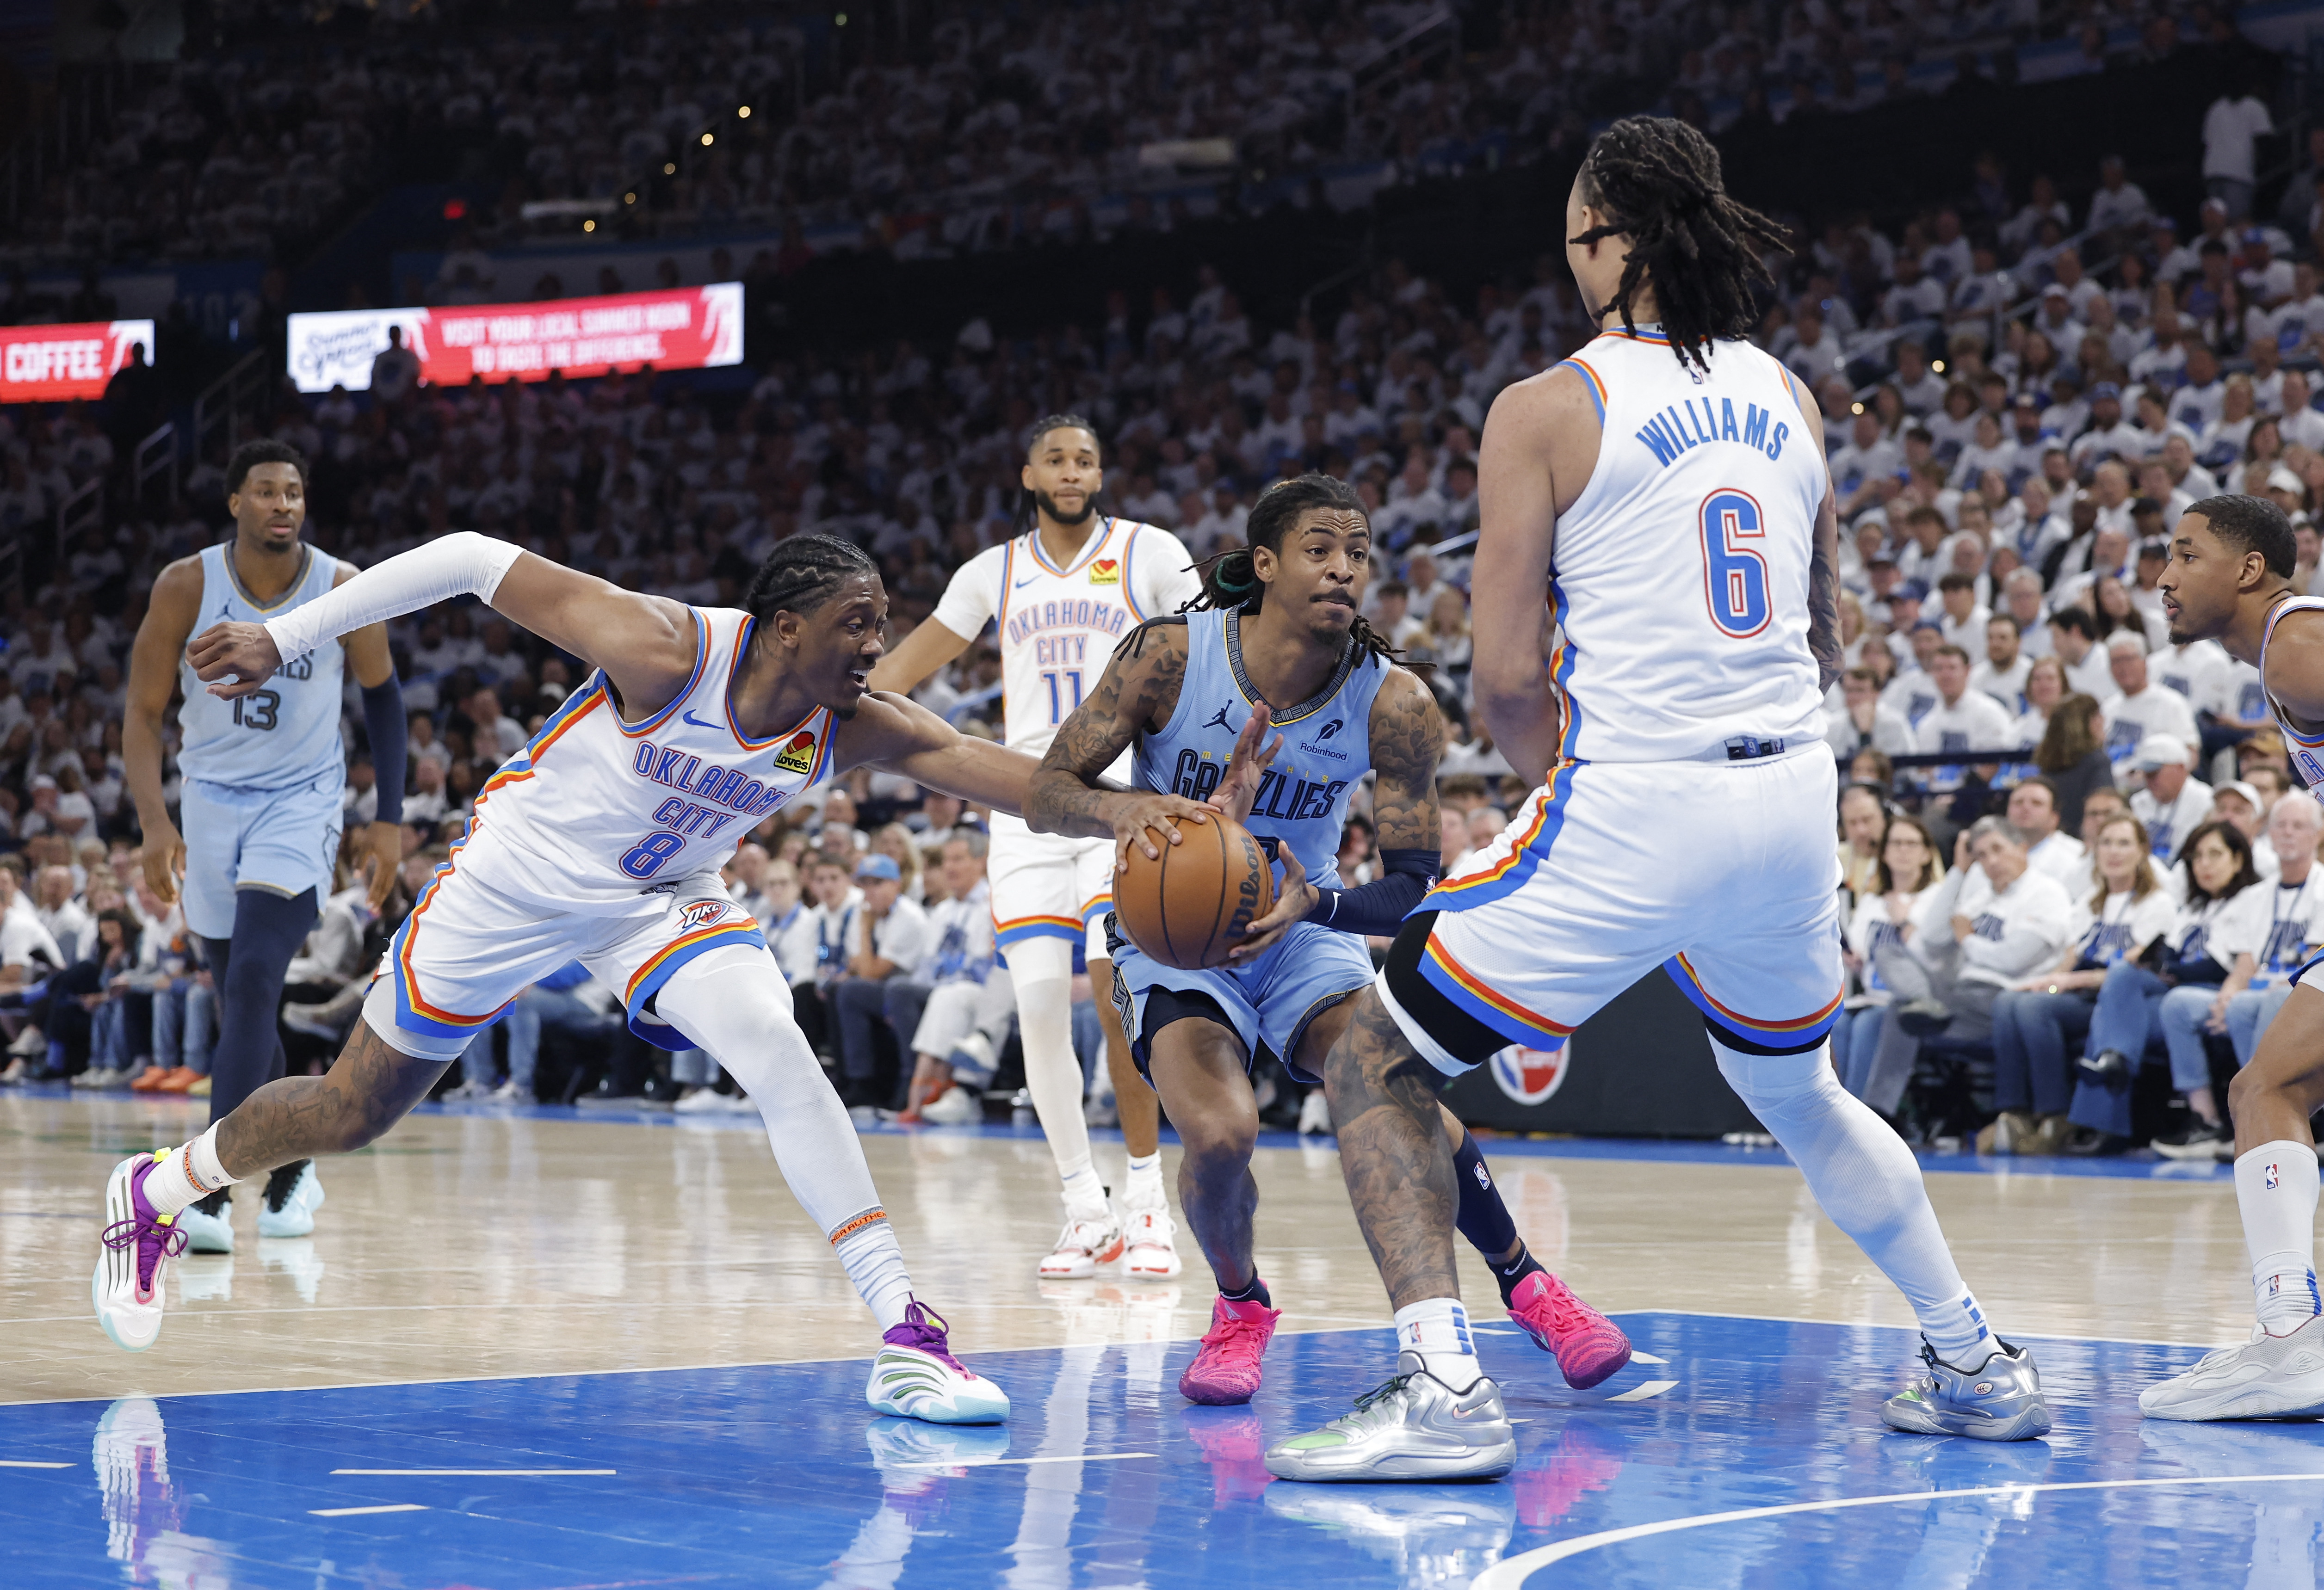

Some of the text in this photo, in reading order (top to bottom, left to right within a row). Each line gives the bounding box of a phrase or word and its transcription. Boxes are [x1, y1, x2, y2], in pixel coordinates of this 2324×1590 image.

[5, 339, 104, 382] COFFEE
[1636, 397, 1789, 468] WILLIAMS
[1699, 487, 1772, 639] 6
[1007, 598, 1128, 646] OKLAHOMA
[1035, 634, 1088, 667] CITY
[234, 689, 280, 731] 13
[1040, 668, 1083, 728] 11
[1201, 752, 1329, 783] MEPHIS
[1300, 742, 1347, 761] Robinhood
[1173, 749, 1348, 820] GRZLIES
[652, 797, 737, 838] CITY
[619, 831, 686, 880] 8
[683, 903, 720, 928] OKC
[831, 1229, 847, 1245] NBA
